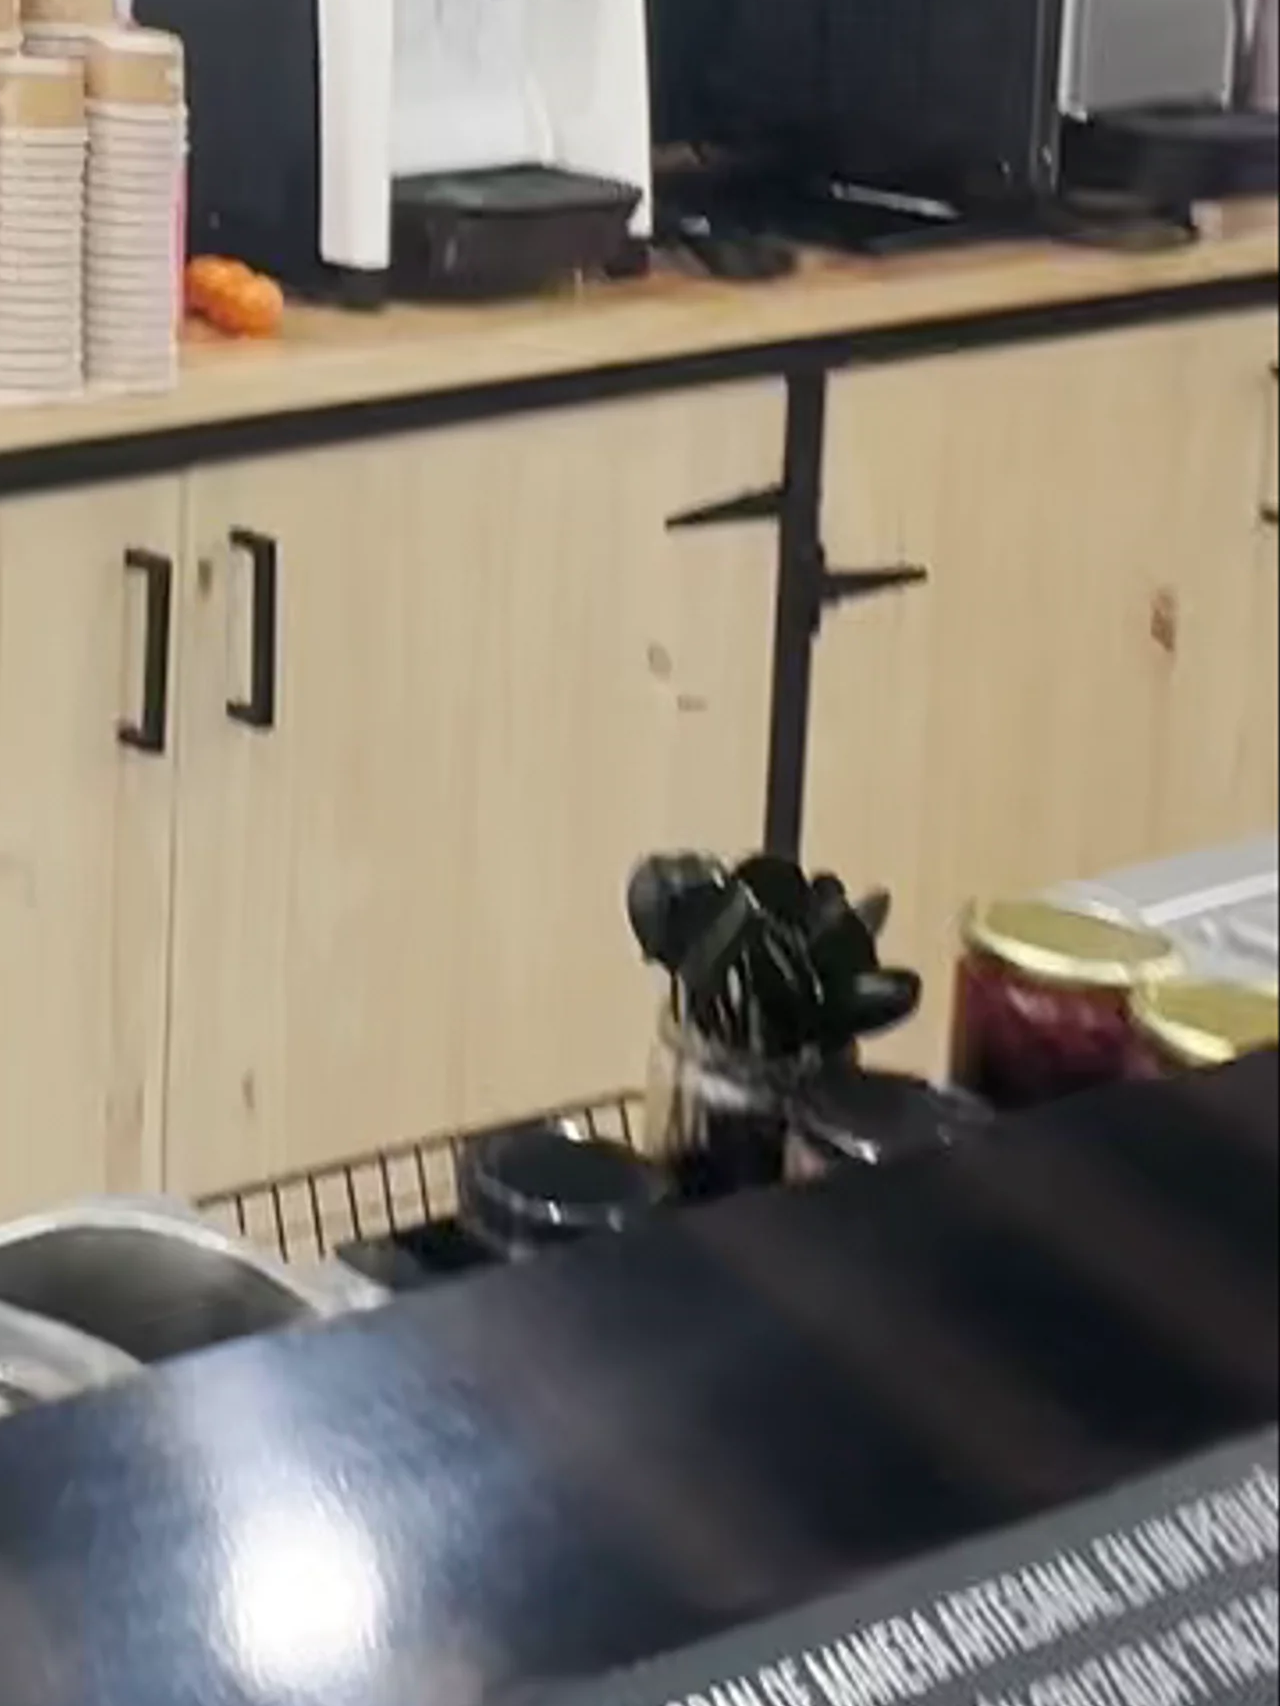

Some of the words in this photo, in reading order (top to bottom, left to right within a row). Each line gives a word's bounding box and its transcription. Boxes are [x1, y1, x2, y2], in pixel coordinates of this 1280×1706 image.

[937, 1549, 1125, 1671] ARTESANAL
[1092, 1530, 1165, 1609] EN
[1132, 1513, 1209, 1590] UN
[1158, 1630, 1212, 1699] Y
